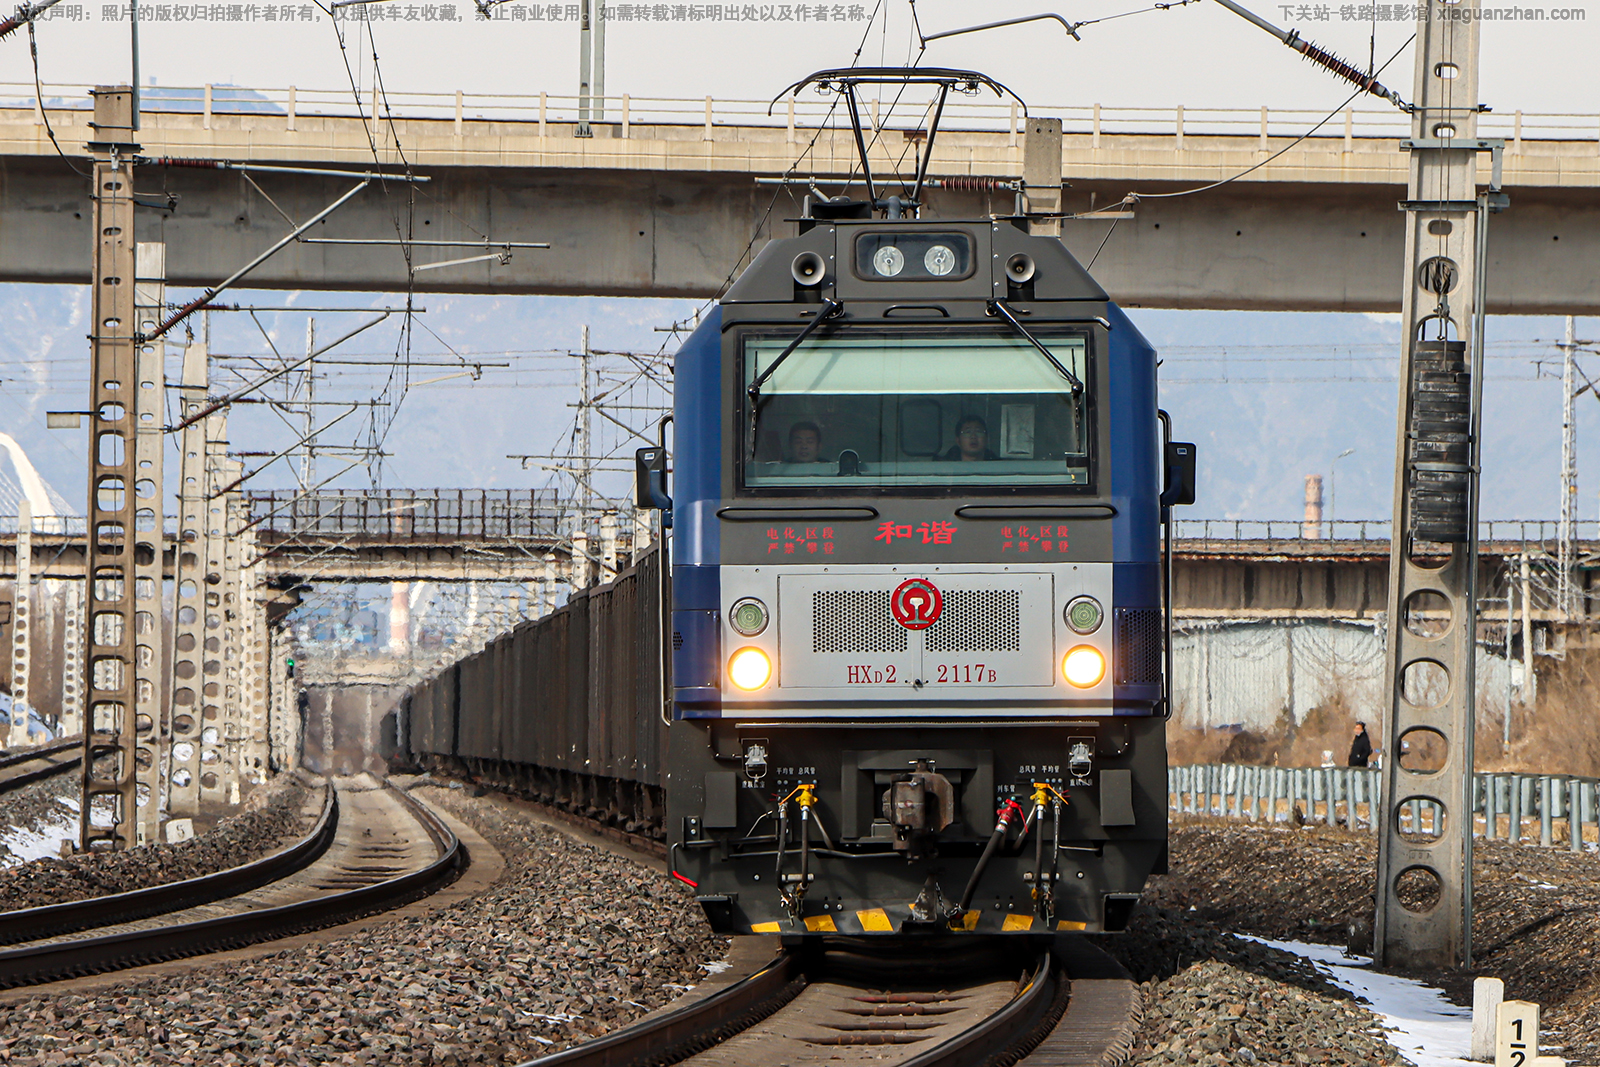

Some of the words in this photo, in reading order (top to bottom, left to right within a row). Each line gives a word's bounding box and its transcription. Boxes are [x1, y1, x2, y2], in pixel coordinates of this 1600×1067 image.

[874, 520, 958, 545] 和谐
[937, 664, 997, 683] 2117B
[1511, 1019, 1523, 1041] 1
[1510, 1051, 1526, 1067] 2
